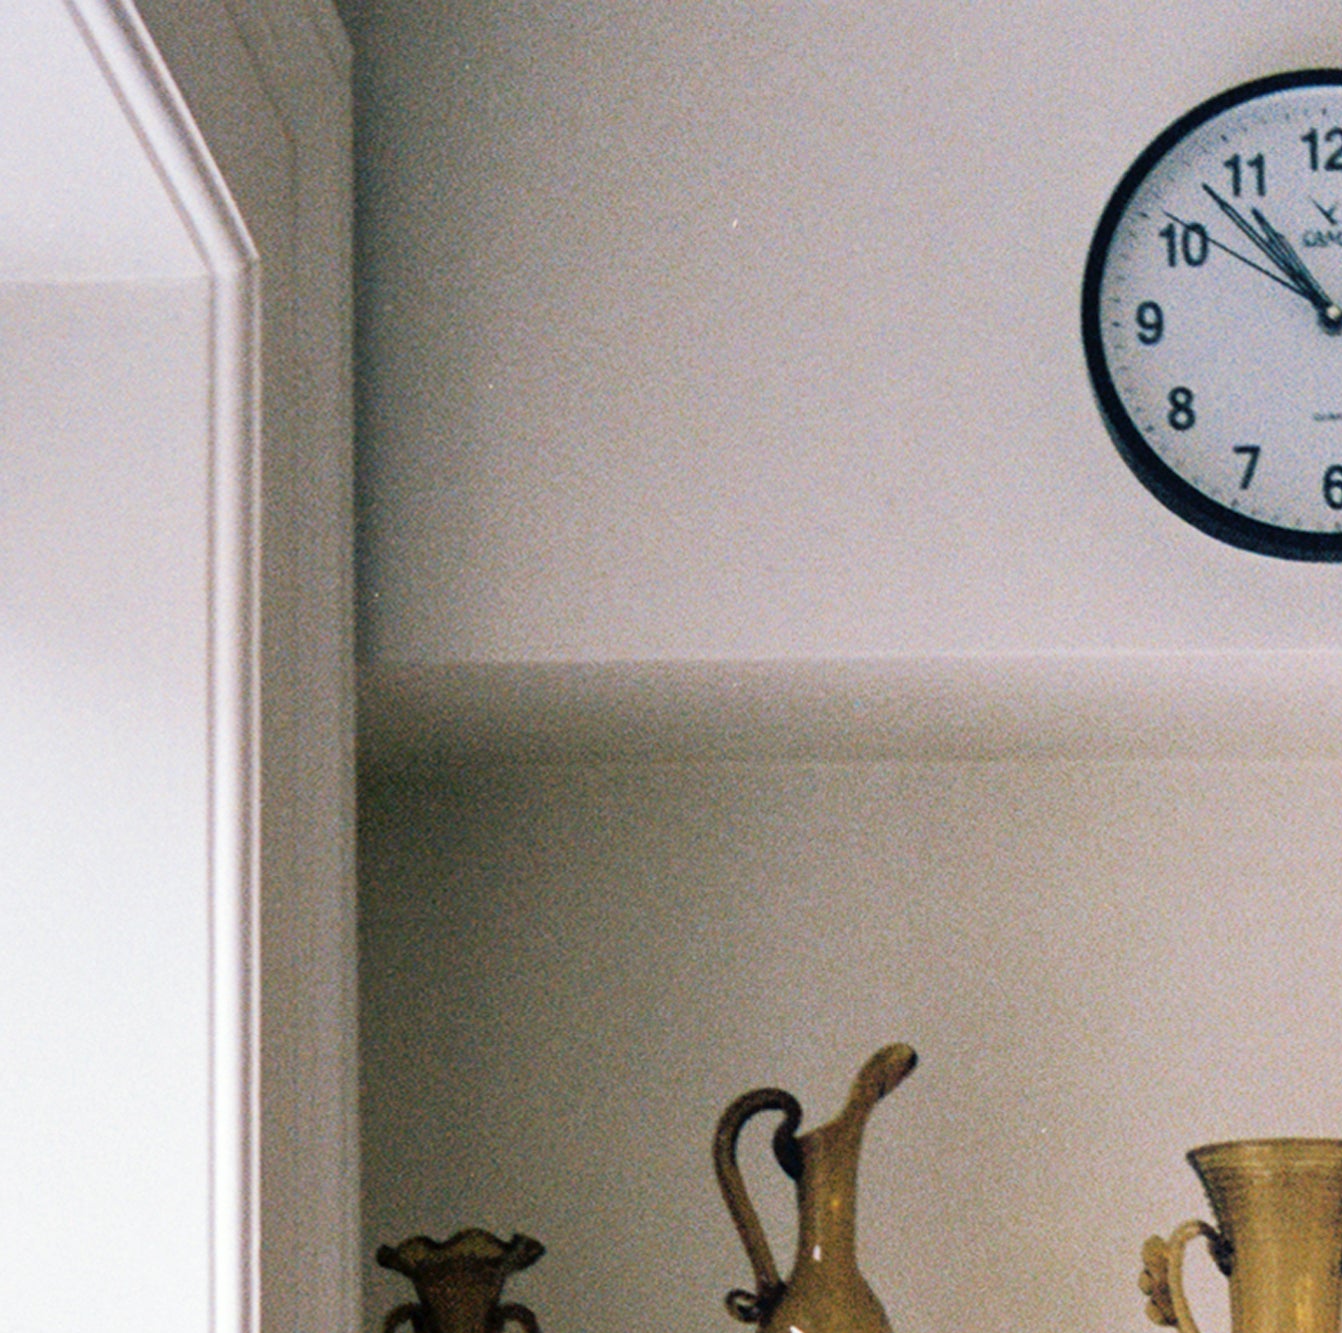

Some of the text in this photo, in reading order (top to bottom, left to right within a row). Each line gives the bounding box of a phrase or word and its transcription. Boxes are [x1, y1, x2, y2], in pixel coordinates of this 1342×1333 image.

[1223, 153, 1266, 197] 11
[1159, 222, 1209, 268] 10
[1135, 301, 1165, 345] 9
[1167, 386, 1196, 431] 8
[1233, 445, 1262, 490] 7
